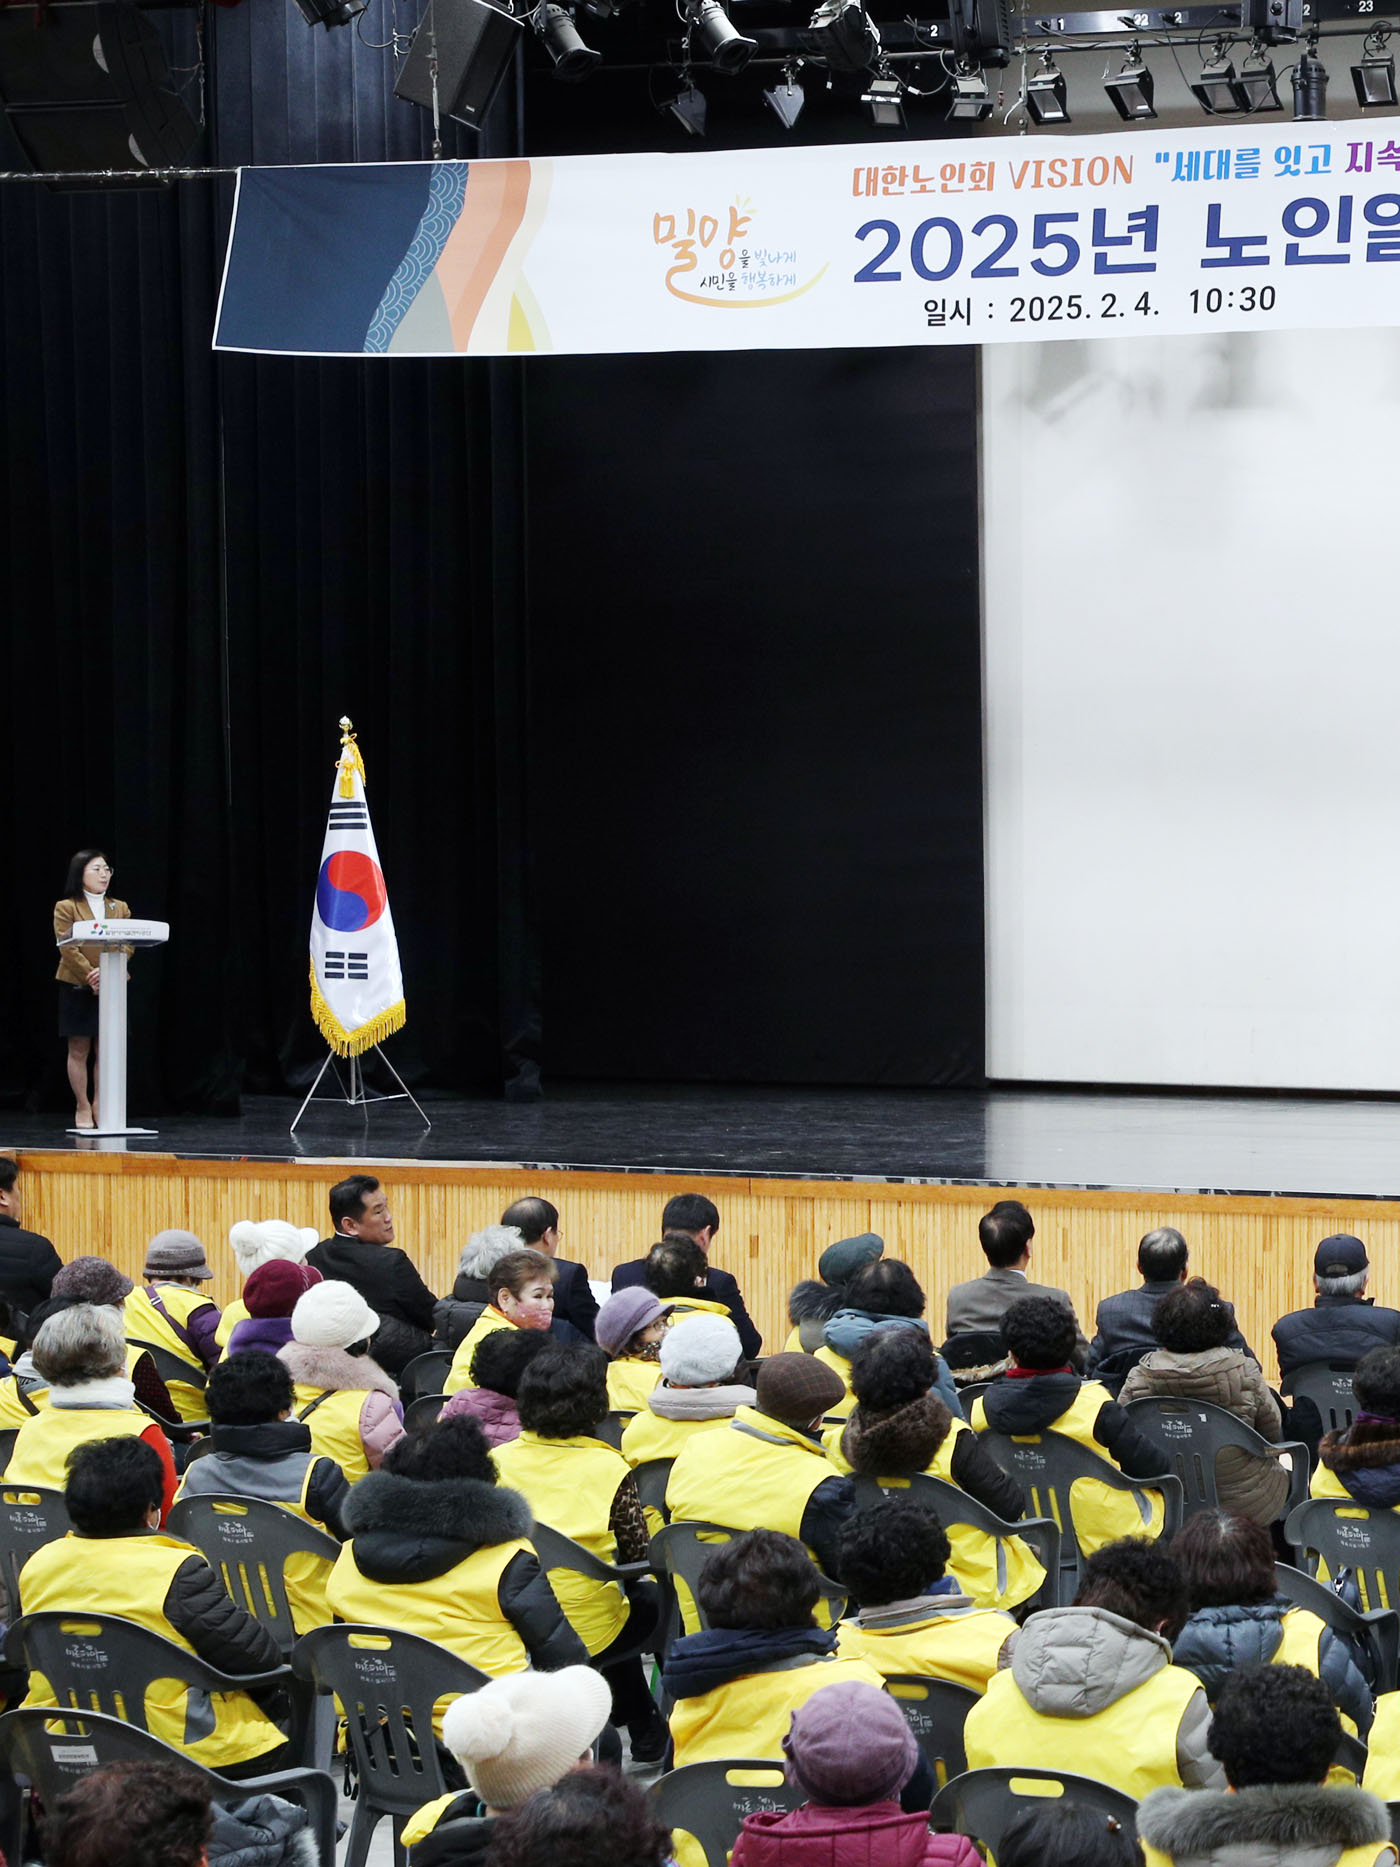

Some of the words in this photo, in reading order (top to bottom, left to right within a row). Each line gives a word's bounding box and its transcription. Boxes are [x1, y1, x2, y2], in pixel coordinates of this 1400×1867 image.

[1358, 1, 1374, 12] 23
[853, 162, 995, 196] 대한노인회
[1009, 155, 1133, 189] VISION
[1155, 148, 1261, 181] "세대를
[1274, 144, 1332, 177] 잇고
[754, 249, 798, 268] 빛나게
[854, 205, 1159, 283] 2025년
[700, 272, 737, 291] 시민을
[741, 271, 798, 290] 행복하게
[924, 298, 971, 326] 일시
[1190, 286, 1275, 314] 10:30
